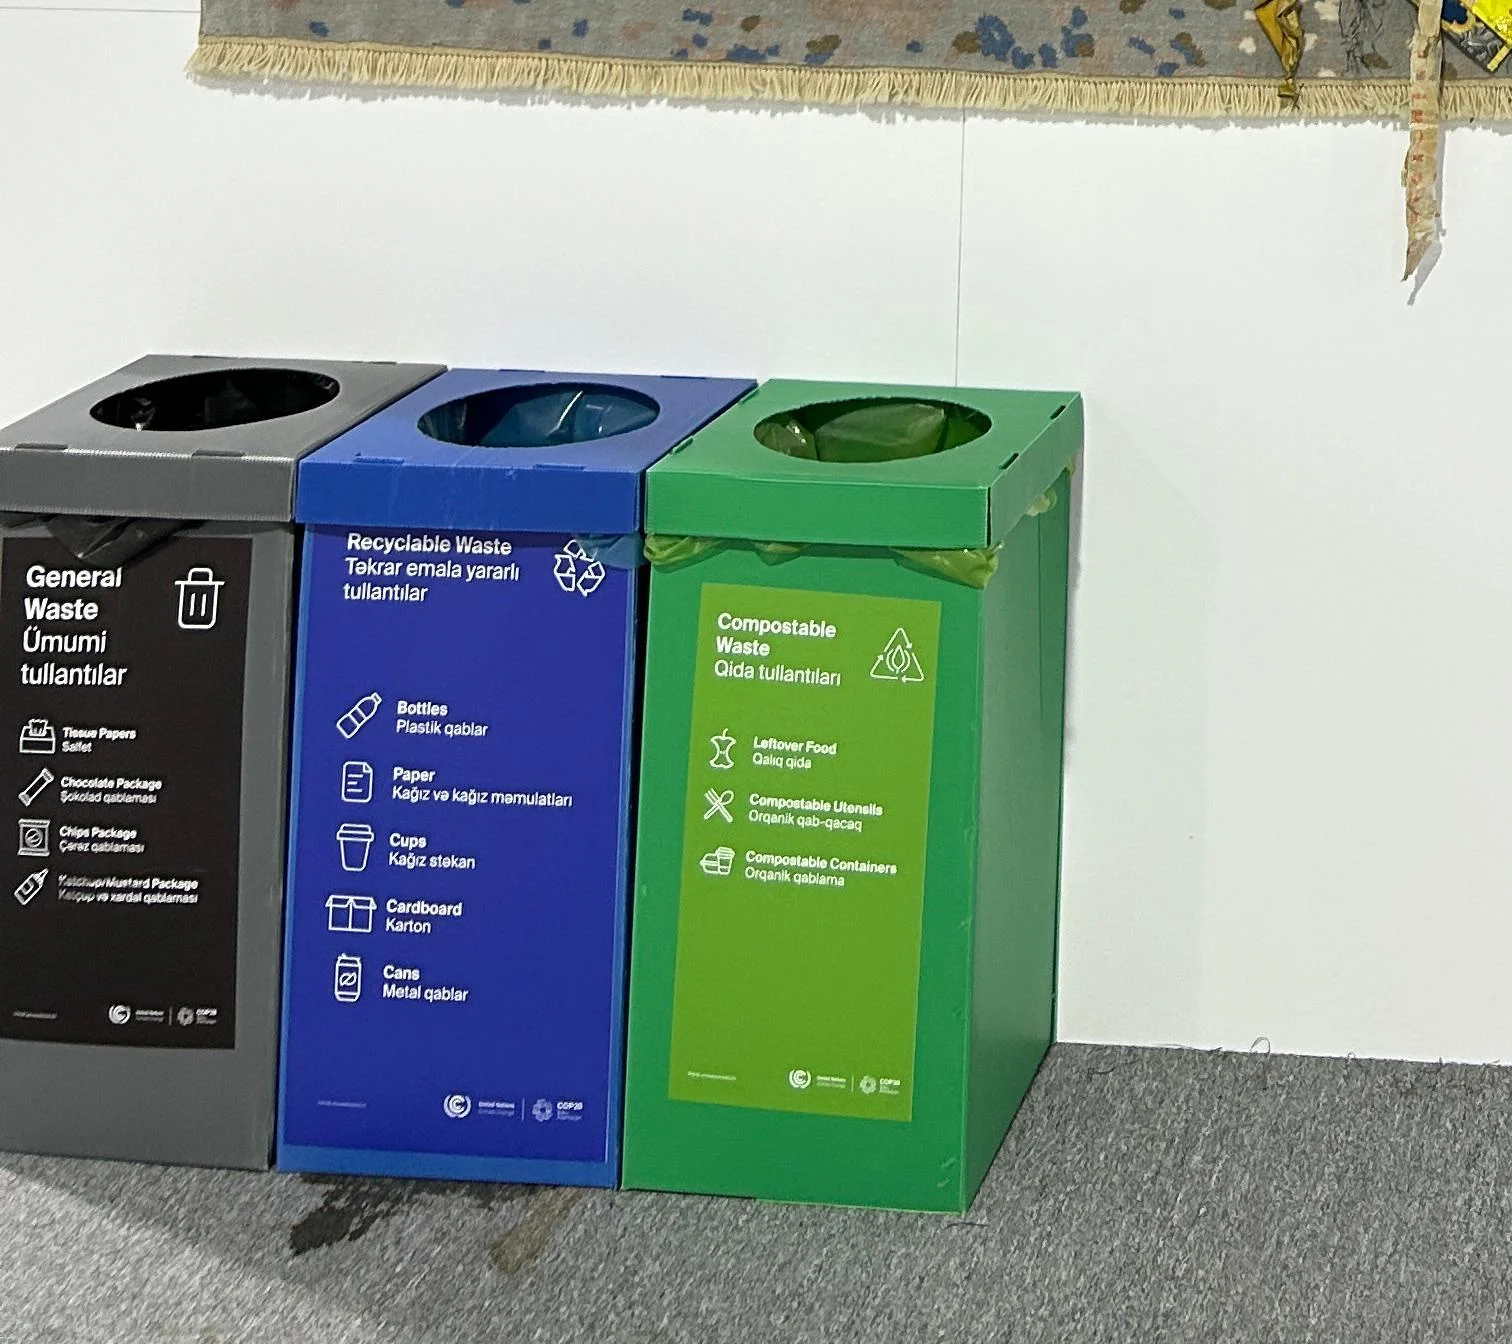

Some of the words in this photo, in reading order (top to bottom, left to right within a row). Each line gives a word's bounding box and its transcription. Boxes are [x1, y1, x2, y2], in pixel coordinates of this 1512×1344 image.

[347, 532, 451, 554] Recyclable
[456, 536, 512, 555] Waste
[26, 565, 123, 588] General
[345, 557, 403, 576] Təkrar
[406, 560, 462, 578] emala
[465, 562, 520, 583] yararlı
[343, 582, 428, 602] tullantılar
[24, 598, 99, 620] Waste
[717, 612, 837, 639] Compostable
[22, 625, 107, 653] Ümumi
[716, 636, 770, 656] Waste
[20, 662, 128, 686] tullantılar
[714, 659, 755, 679] Qida
[758, 664, 842, 687] tullantıları
[397, 700, 448, 716] Bottles
[99, 728, 137, 741] Papers
[396, 719, 442, 735] Plastik
[444, 722, 488, 738] qablar
[753, 735, 804, 753] Leftover
[806, 741, 837, 755] Food
[785, 756, 812, 770] qida
[60, 776, 115, 789] Chocolate
[116, 778, 162, 791] Package
[393, 766, 436, 784] Paper
[392, 785, 430, 803] Kağız
[433, 790, 449, 801] və
[452, 788, 488, 806] kağız
[749, 793, 832, 812] Compostable
[833, 799, 883, 816] Utensils
[59, 826, 90, 839] Chips
[389, 832, 427, 850] Cups
[388, 852, 427, 870] Kağız
[745, 850, 828, 869] Compostable
[830, 857, 898, 874] Containers
[152, 877, 199, 891] Package
[386, 898, 463, 917] Cardboard
[385, 917, 431, 934] Karton
[383, 965, 420, 981] Cans
[382, 984, 421, 1000] Metal
[424, 986, 469, 1003] qablar
